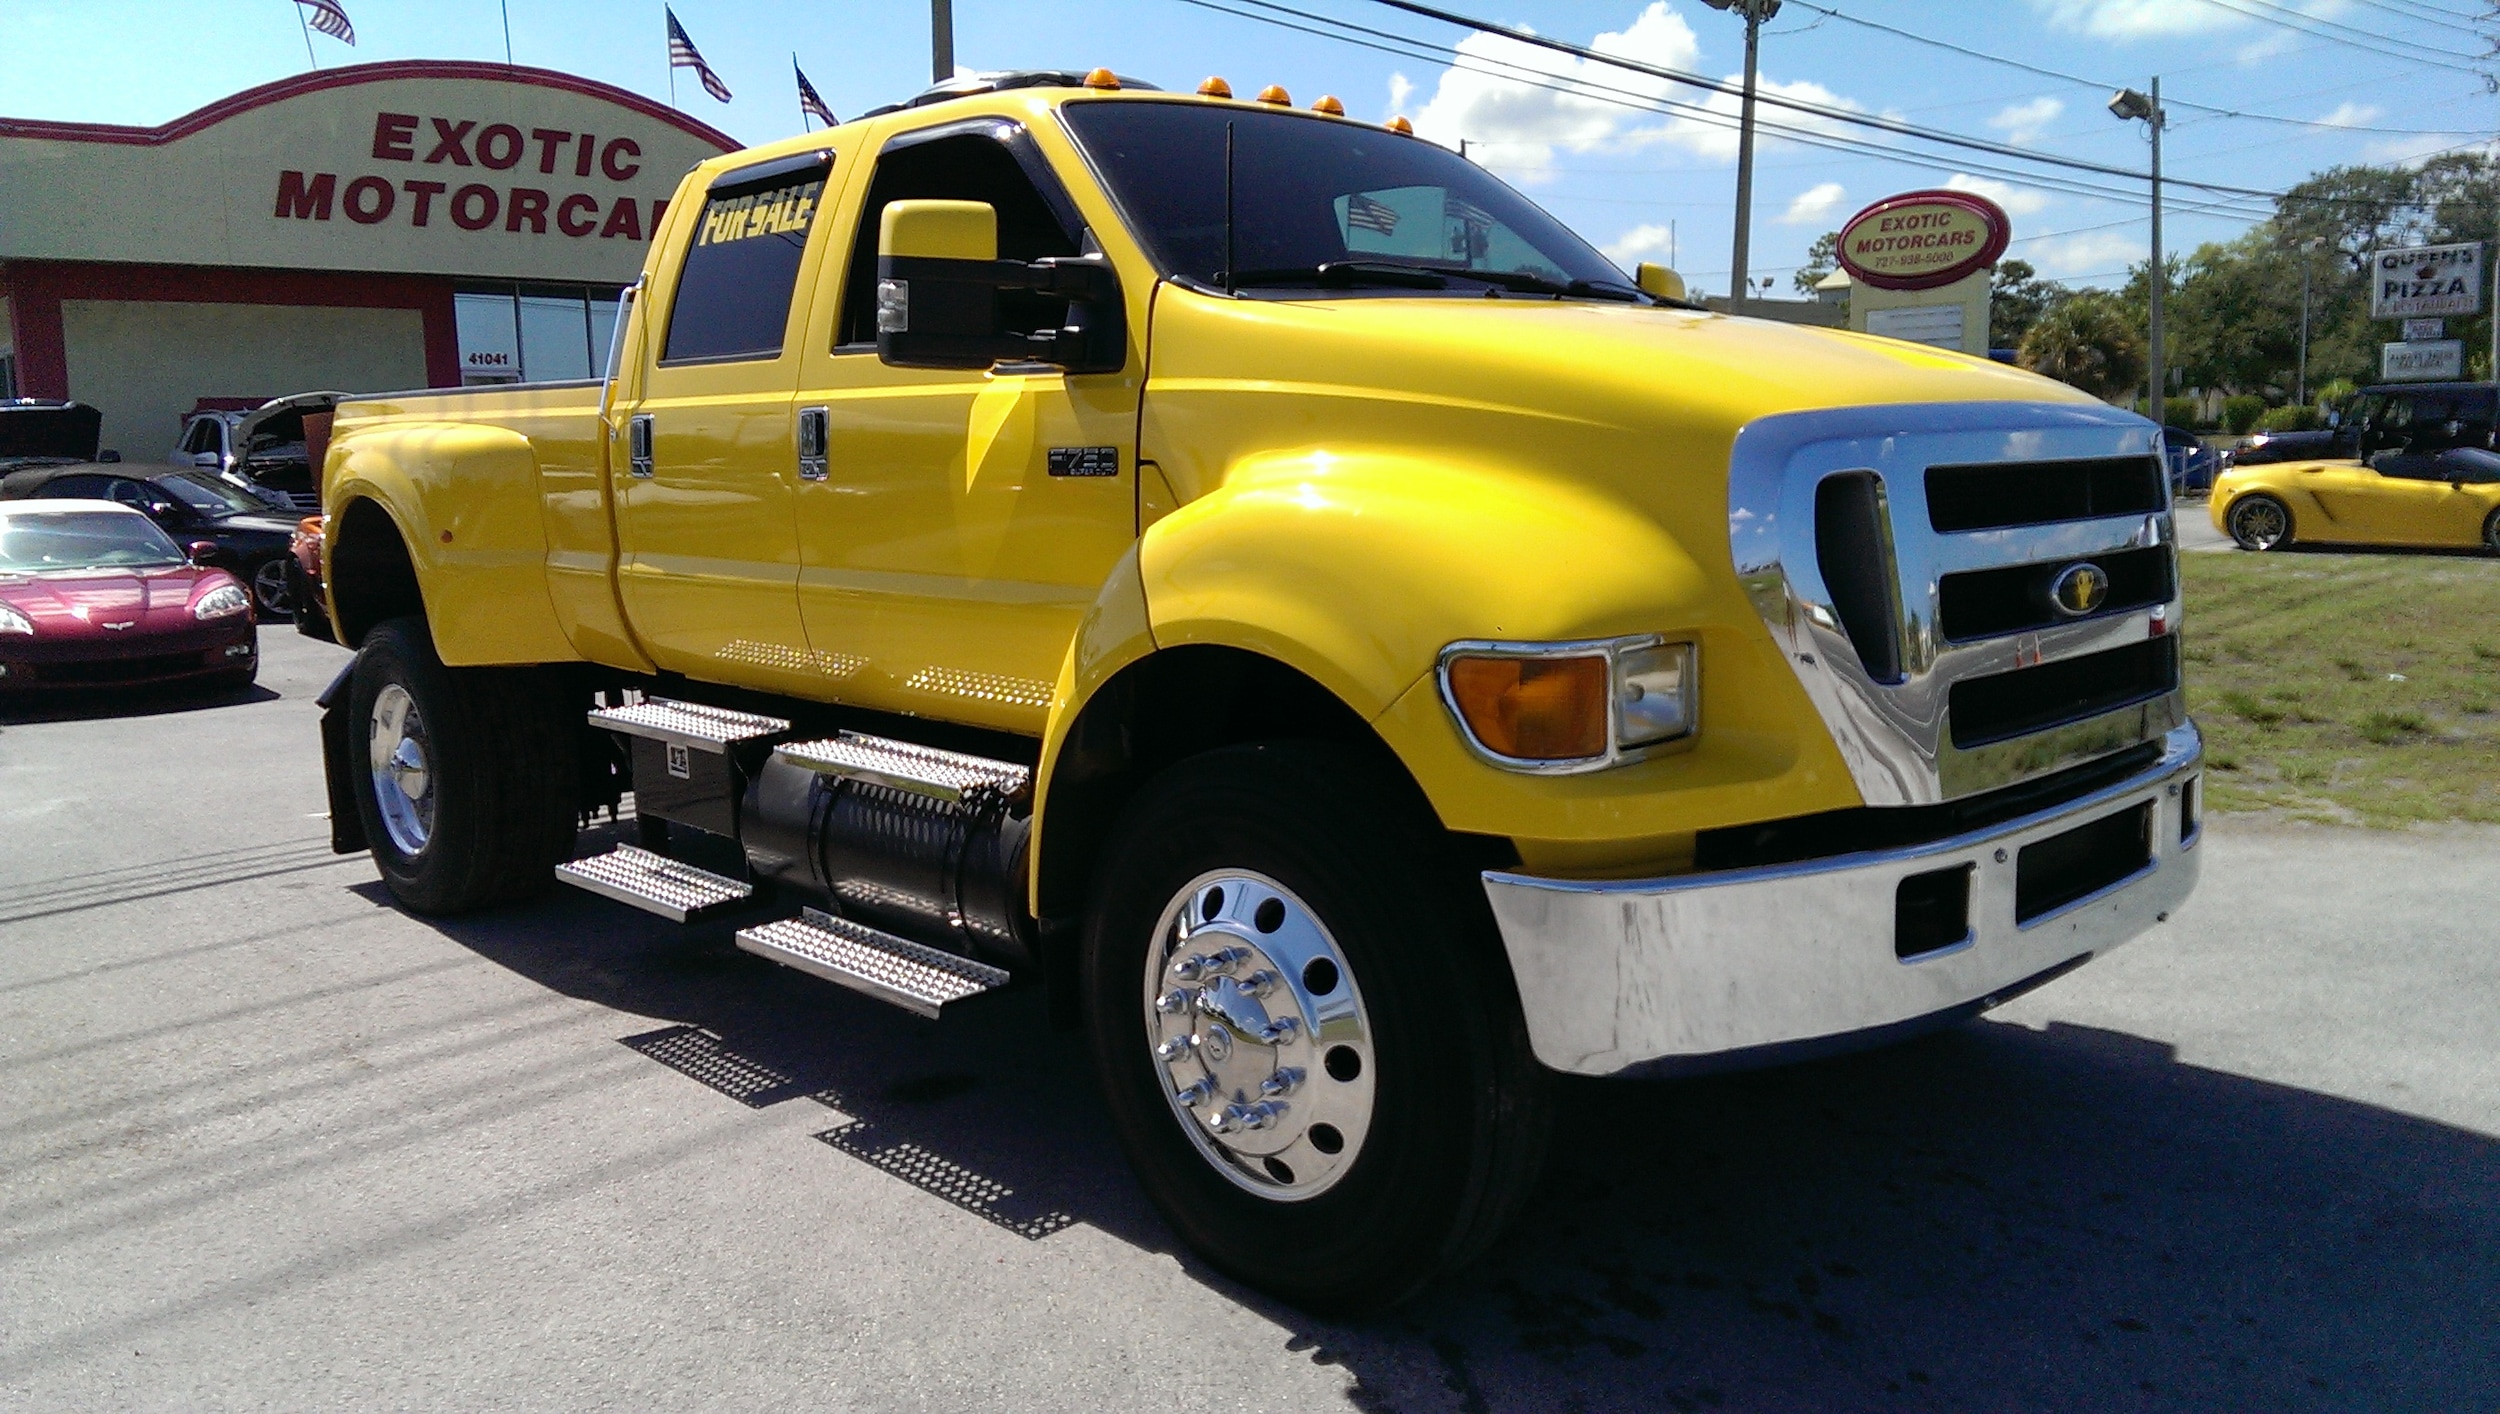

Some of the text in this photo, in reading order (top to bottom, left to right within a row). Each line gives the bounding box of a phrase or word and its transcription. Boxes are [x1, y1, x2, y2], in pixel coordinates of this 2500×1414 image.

[372, 112, 641, 181] EXOTIC
[698, 181, 819, 247] FOR SALE
[1880, 212, 1951, 232] EXOTIC
[1856, 229, 1976, 254] MOTORCARS
[2384, 275, 2466, 299] PIZZA
[468, 352, 508, 365] 41041
